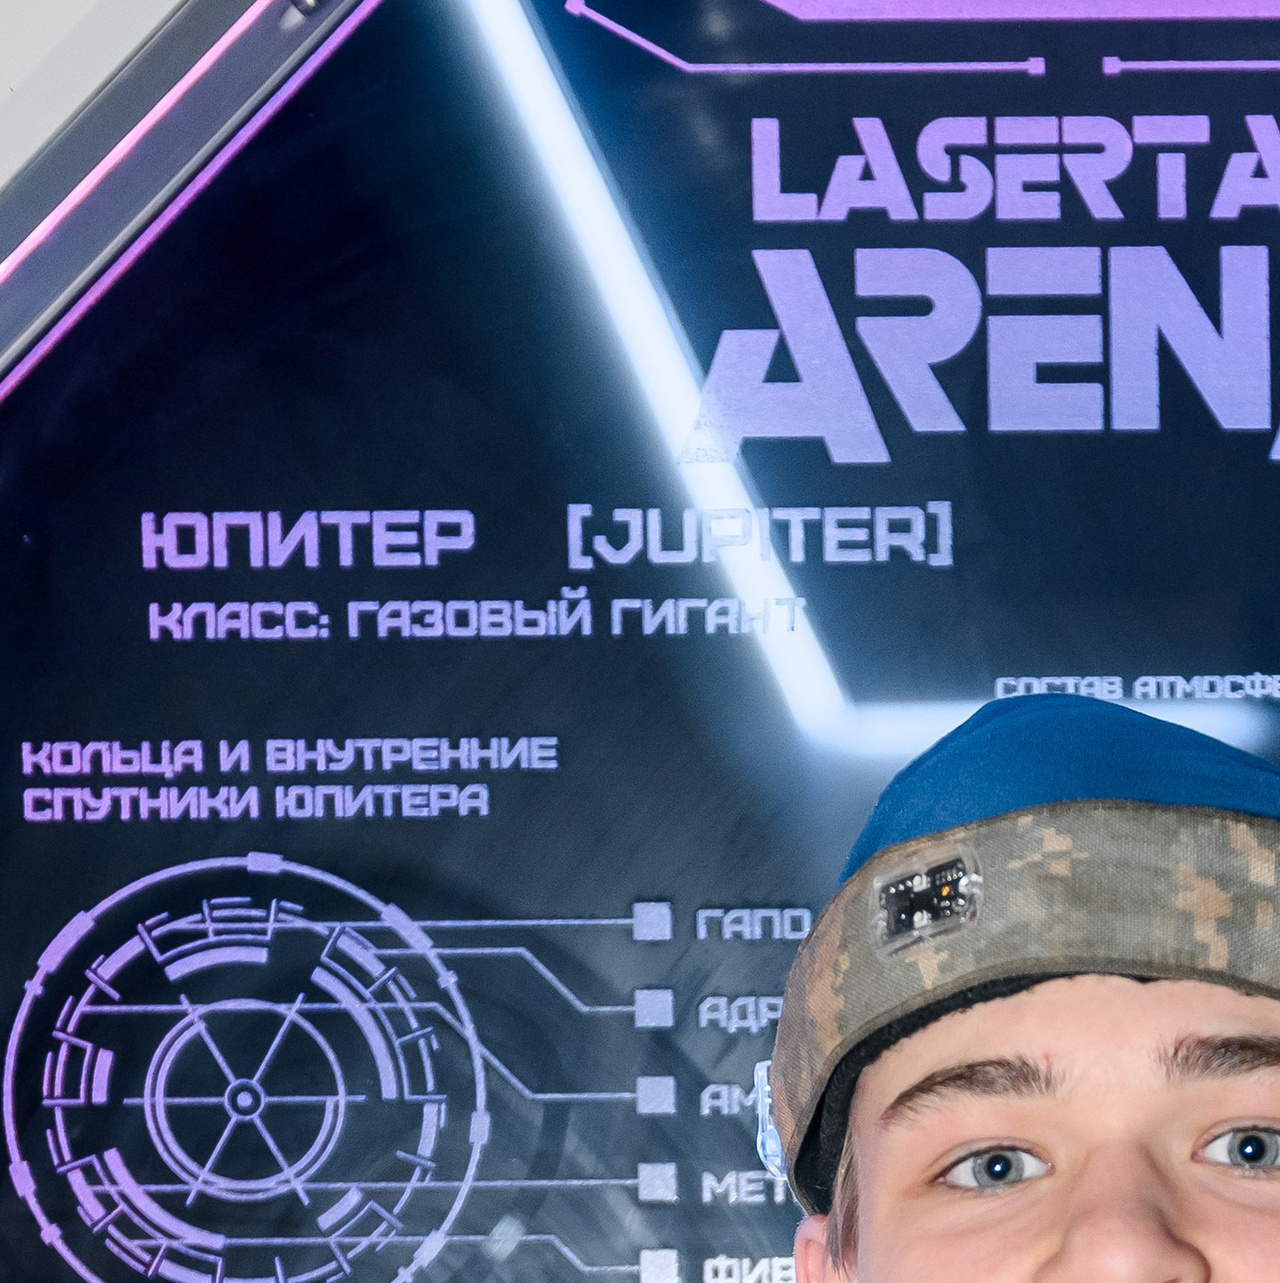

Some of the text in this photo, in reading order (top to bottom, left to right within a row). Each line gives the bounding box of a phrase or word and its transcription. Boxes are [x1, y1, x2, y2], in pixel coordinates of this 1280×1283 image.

[141, 510, 476, 569] ЮПИТЕР
[567, 501, 953, 569] [JUPITER]
[149, 586, 805, 640] КЛАСС: ГАЗОВЫЙ ГИГАНТ
[994, 676, 1123, 701] СОСТАВ
[22, 737, 559, 778] КОЛЬЦА И ВНУТРЕННИЕ
[23, 784, 490, 822] СПУТНИКИ ЮПИТЕРА
